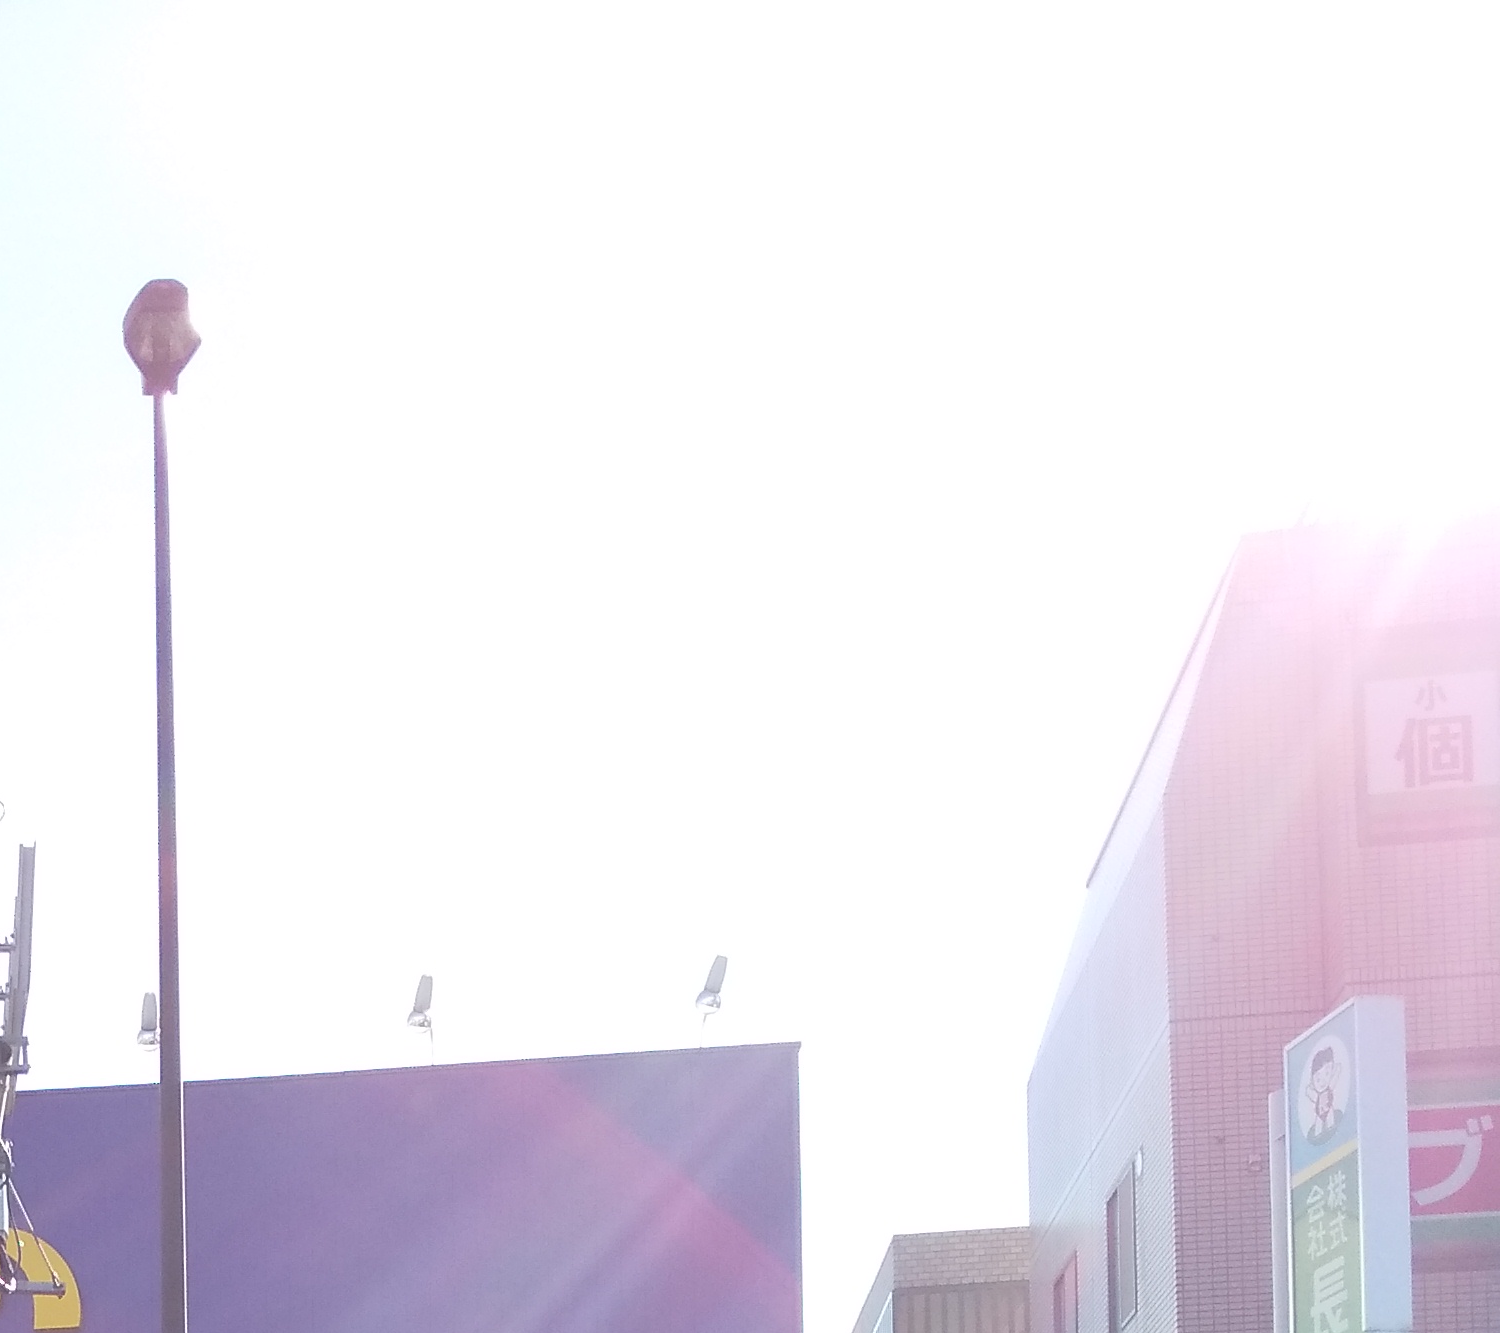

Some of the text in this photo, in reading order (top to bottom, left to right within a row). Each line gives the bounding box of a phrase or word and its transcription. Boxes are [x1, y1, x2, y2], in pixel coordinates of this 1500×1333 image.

[1414, 679, 1447, 712] 小
[1395, 714, 1474, 788] 個
[1307, 1185, 1327, 1261] 会社
[1328, 1170, 1347, 1250] 株式
